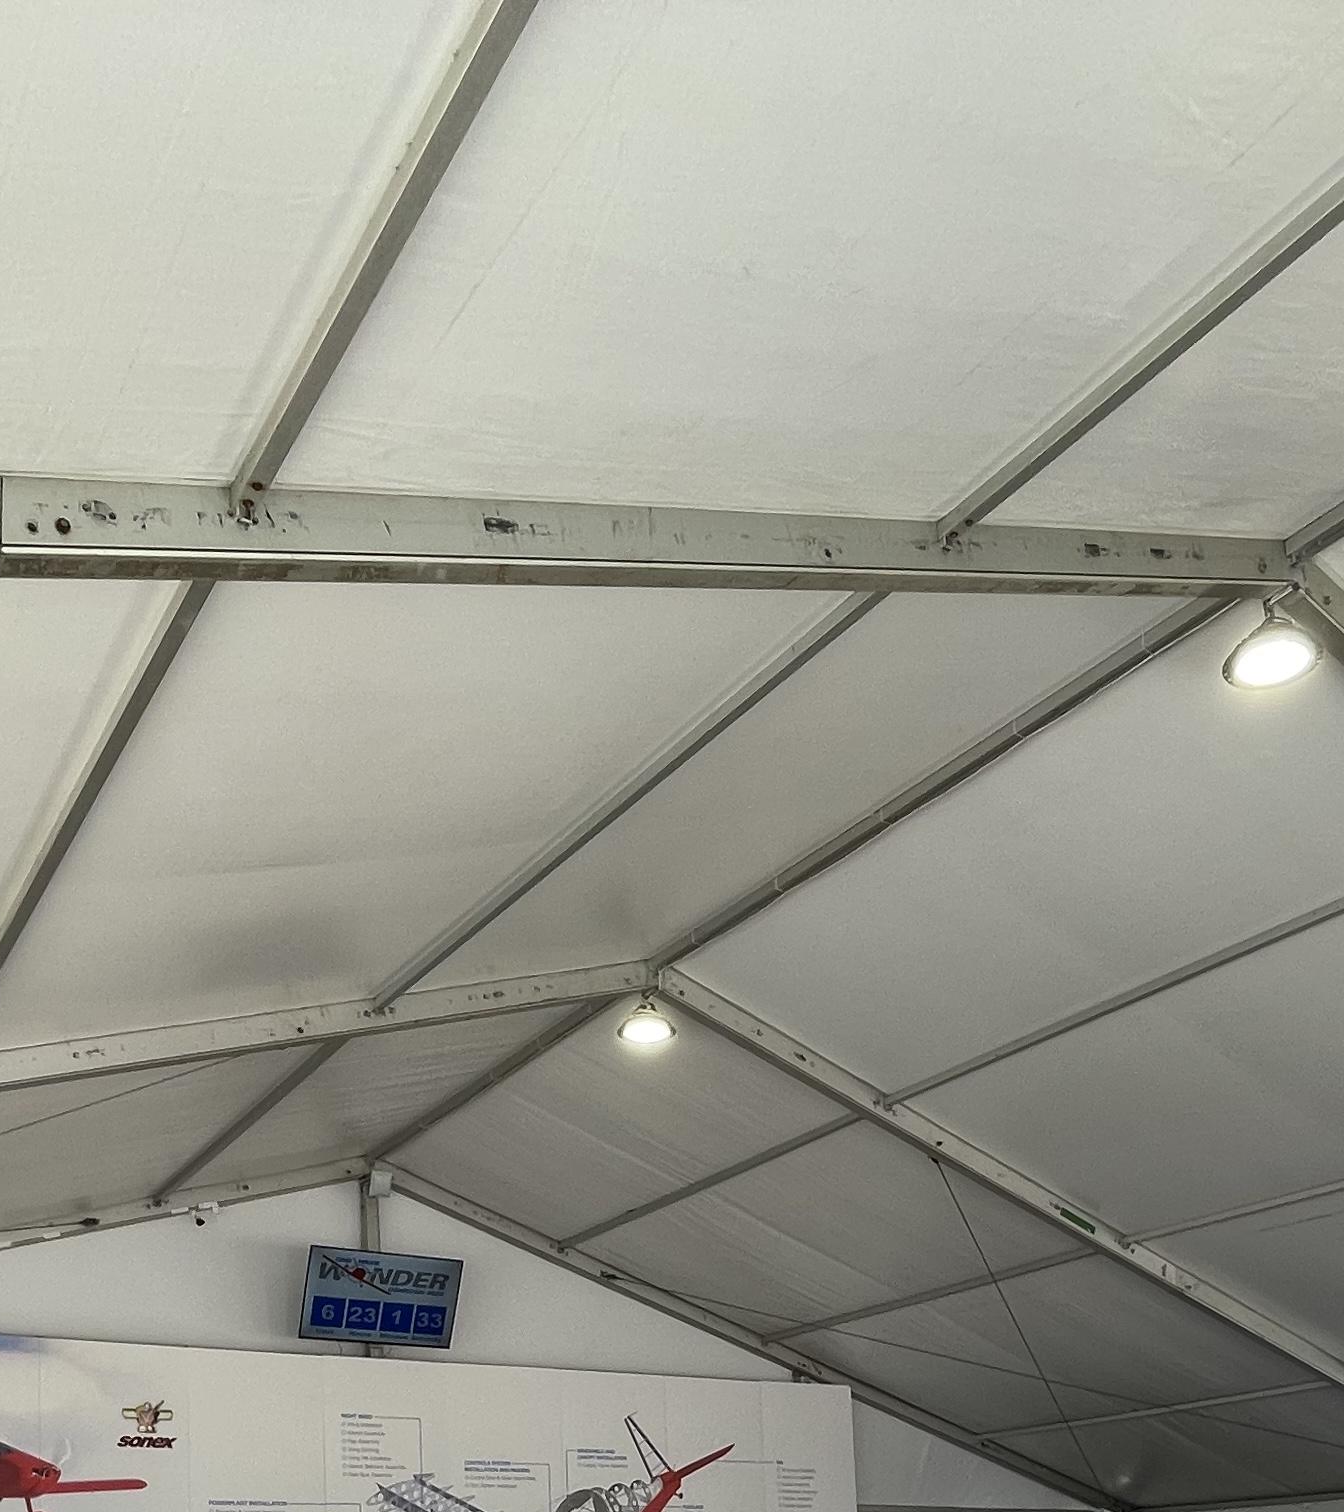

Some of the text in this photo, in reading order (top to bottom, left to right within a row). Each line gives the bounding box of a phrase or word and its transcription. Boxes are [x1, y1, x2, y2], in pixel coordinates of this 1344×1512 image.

[322, 1305, 442, 1328] 6 23 1 33
[117, 1436, 177, 1448] sonex
